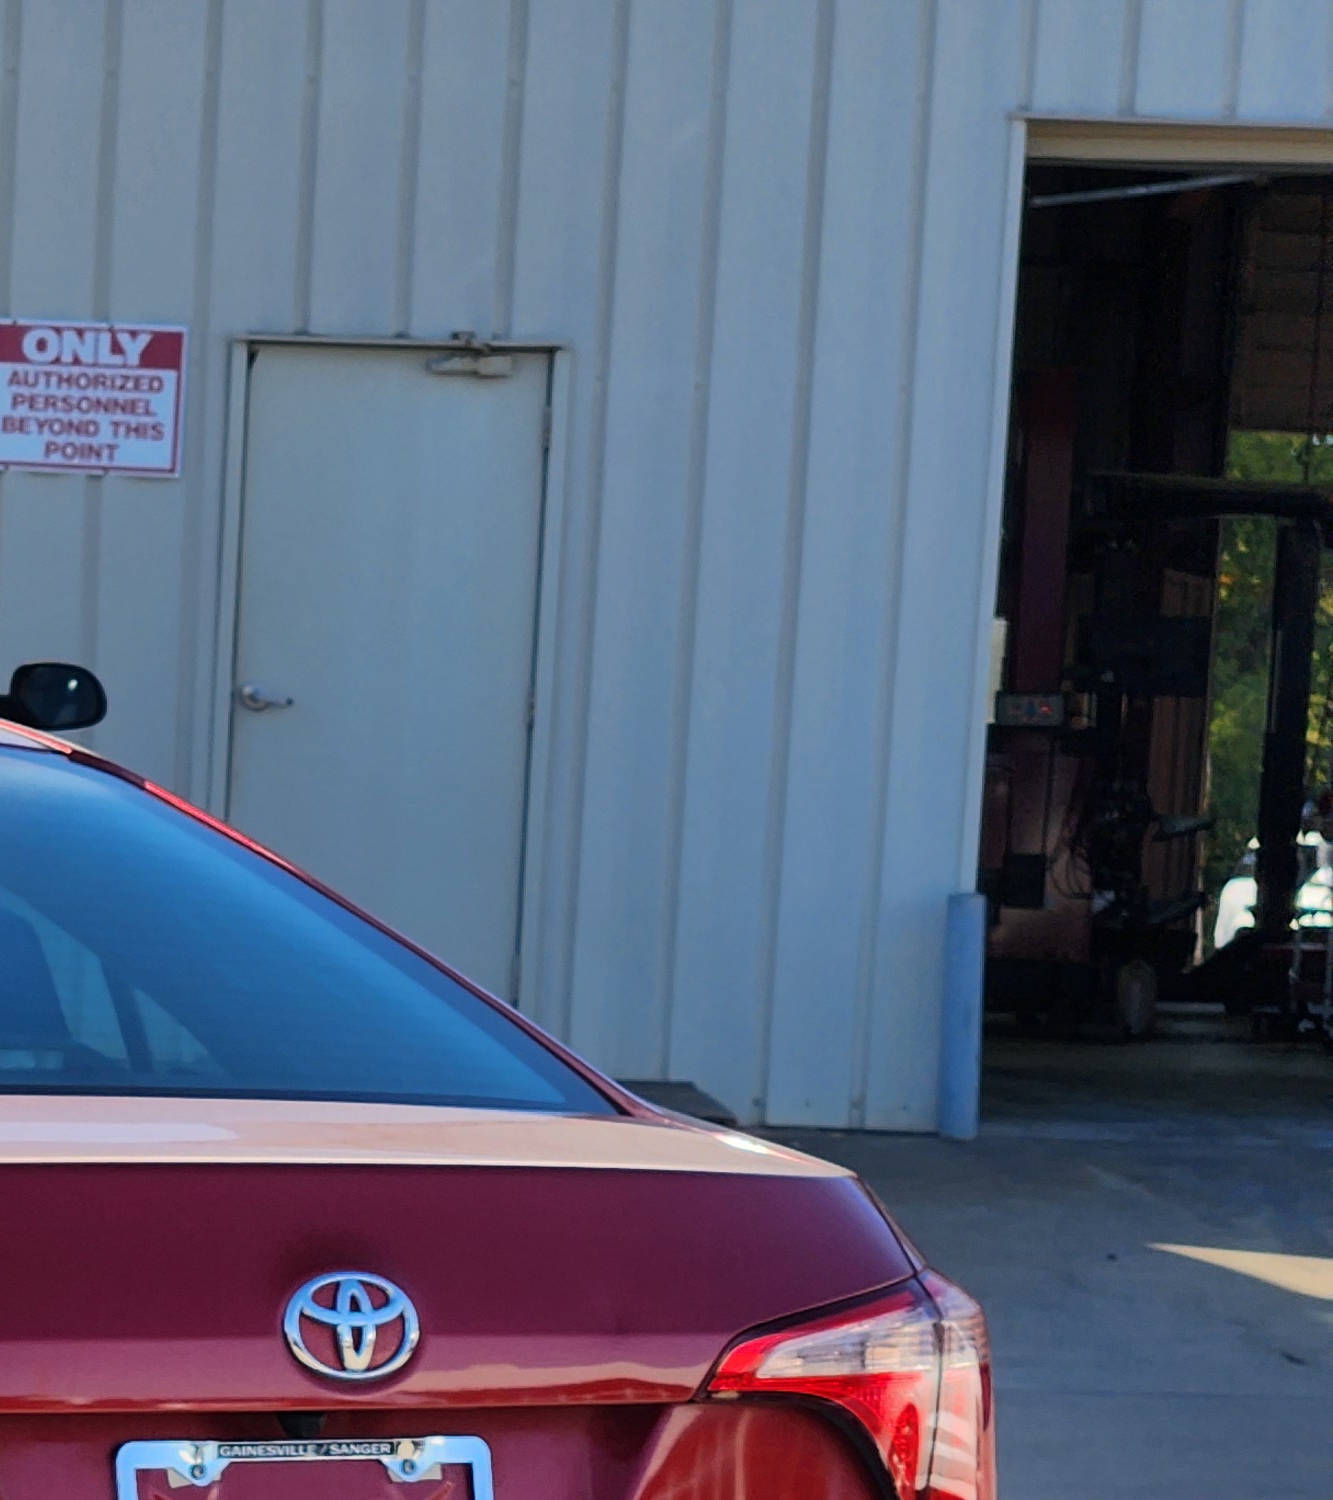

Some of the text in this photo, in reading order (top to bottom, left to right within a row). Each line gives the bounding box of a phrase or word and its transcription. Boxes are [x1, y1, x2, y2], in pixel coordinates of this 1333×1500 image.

[21, 327, 154, 366] ONLY
[7, 369, 165, 394] AUTHORIZED
[10, 392, 158, 417] PERSONNEL
[0, 416, 165, 442] BEYOND THIS
[43, 441, 120, 462] POINT
